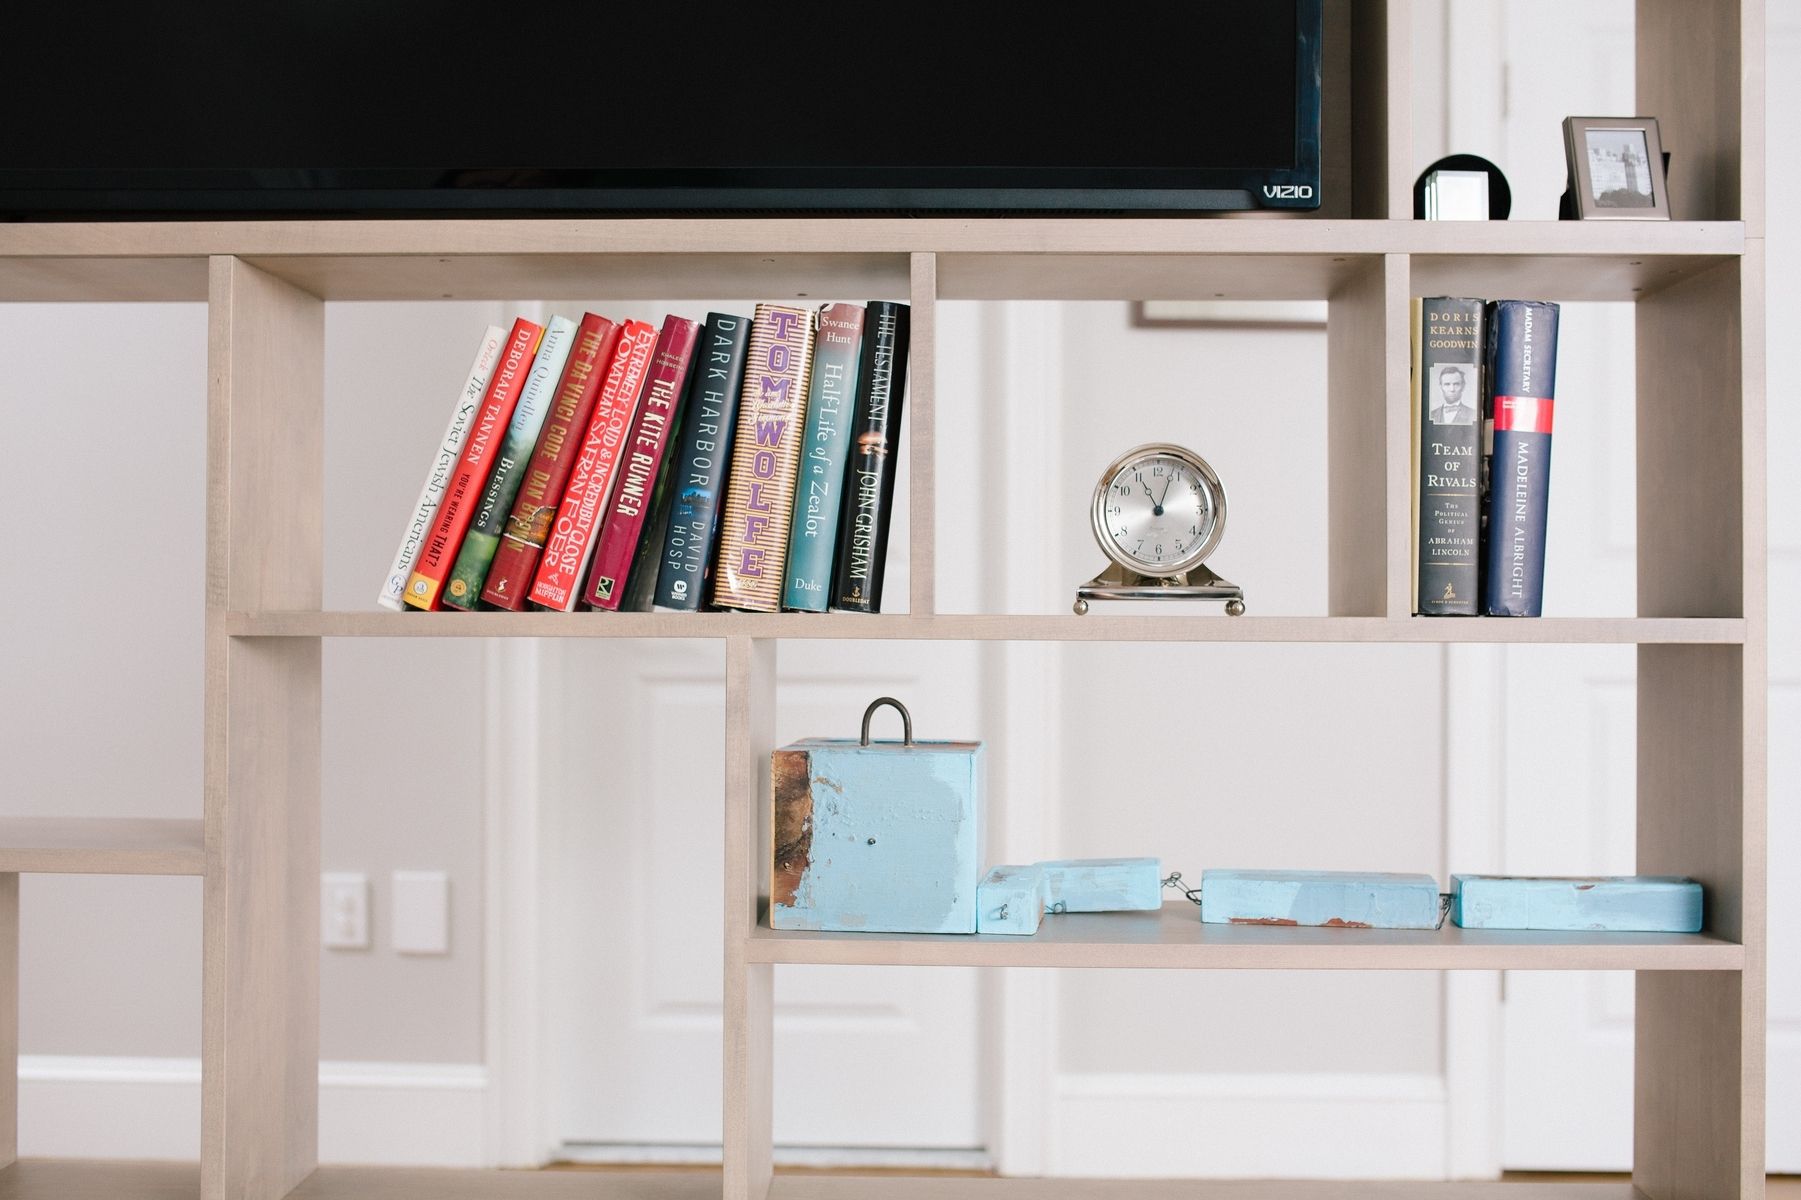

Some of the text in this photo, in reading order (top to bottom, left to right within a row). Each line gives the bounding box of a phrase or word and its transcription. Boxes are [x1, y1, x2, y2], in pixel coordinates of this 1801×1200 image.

[1263, 185, 1313, 199] VIZIO
[821, 317, 861, 331] Swanee
[1430, 312, 1481, 322] DORIS
[826, 332, 852, 344] Hunt
[1430, 326, 1479, 336] KEARNS
[1429, 340, 1478, 349] GOODWIN
[1522, 307, 1533, 393] MADAM SECRETARY
[760, 310, 799, 403] TOM
[466, 376, 486, 400] The
[467, 329, 531, 464] DEBORAH TANNEN
[541, 330, 603, 461] THE DA VINCI CODE
[689, 319, 737, 485] DARK HARBOR
[447, 401, 476, 446] Soviet
[545, 326, 636, 567] JONATHAN SAFRAN FOER
[559, 329, 655, 576] EXTREMELY LOUD & INCREDIBLY CLOSE
[616, 379, 675, 517] THE KITE RUNNER
[804, 363, 843, 538] Half-Life of a Zealot
[1432, 443, 1473, 456] TEAM
[428, 446, 457, 493] Jewish
[1153, 467, 1164, 477] 12
[1444, 462, 1461, 472] OF
[1135, 473, 1142, 483] 11
[1428, 475, 1477, 488] RIVALS
[738, 419, 788, 578] WOLFE
[1120, 486, 1131, 497] 10
[507, 470, 550, 553] DAN BROWN
[1114, 506, 1121, 517] 9
[425, 473, 471, 568] YOU'RE WEARING THAT?
[849, 469, 879, 579] JOHN GRISHAM
[1511, 441, 1529, 598] MADELEINE ALBRIGHT
[398, 495, 437, 570] Americans
[1121, 526, 1128, 537] 8
[1189, 525, 1196, 536] 4
[668, 525, 688, 570] HOSP
[684, 521, 706, 573] DAVID
[1137, 540, 1144, 551] 7
[1175, 539, 1182, 550] 5
[1428, 537, 1474, 545] ABRAHAM
[1155, 544, 1162, 555] 6
[1432, 548, 1470, 556] LINCOLN
[795, 578, 822, 592] Duke
